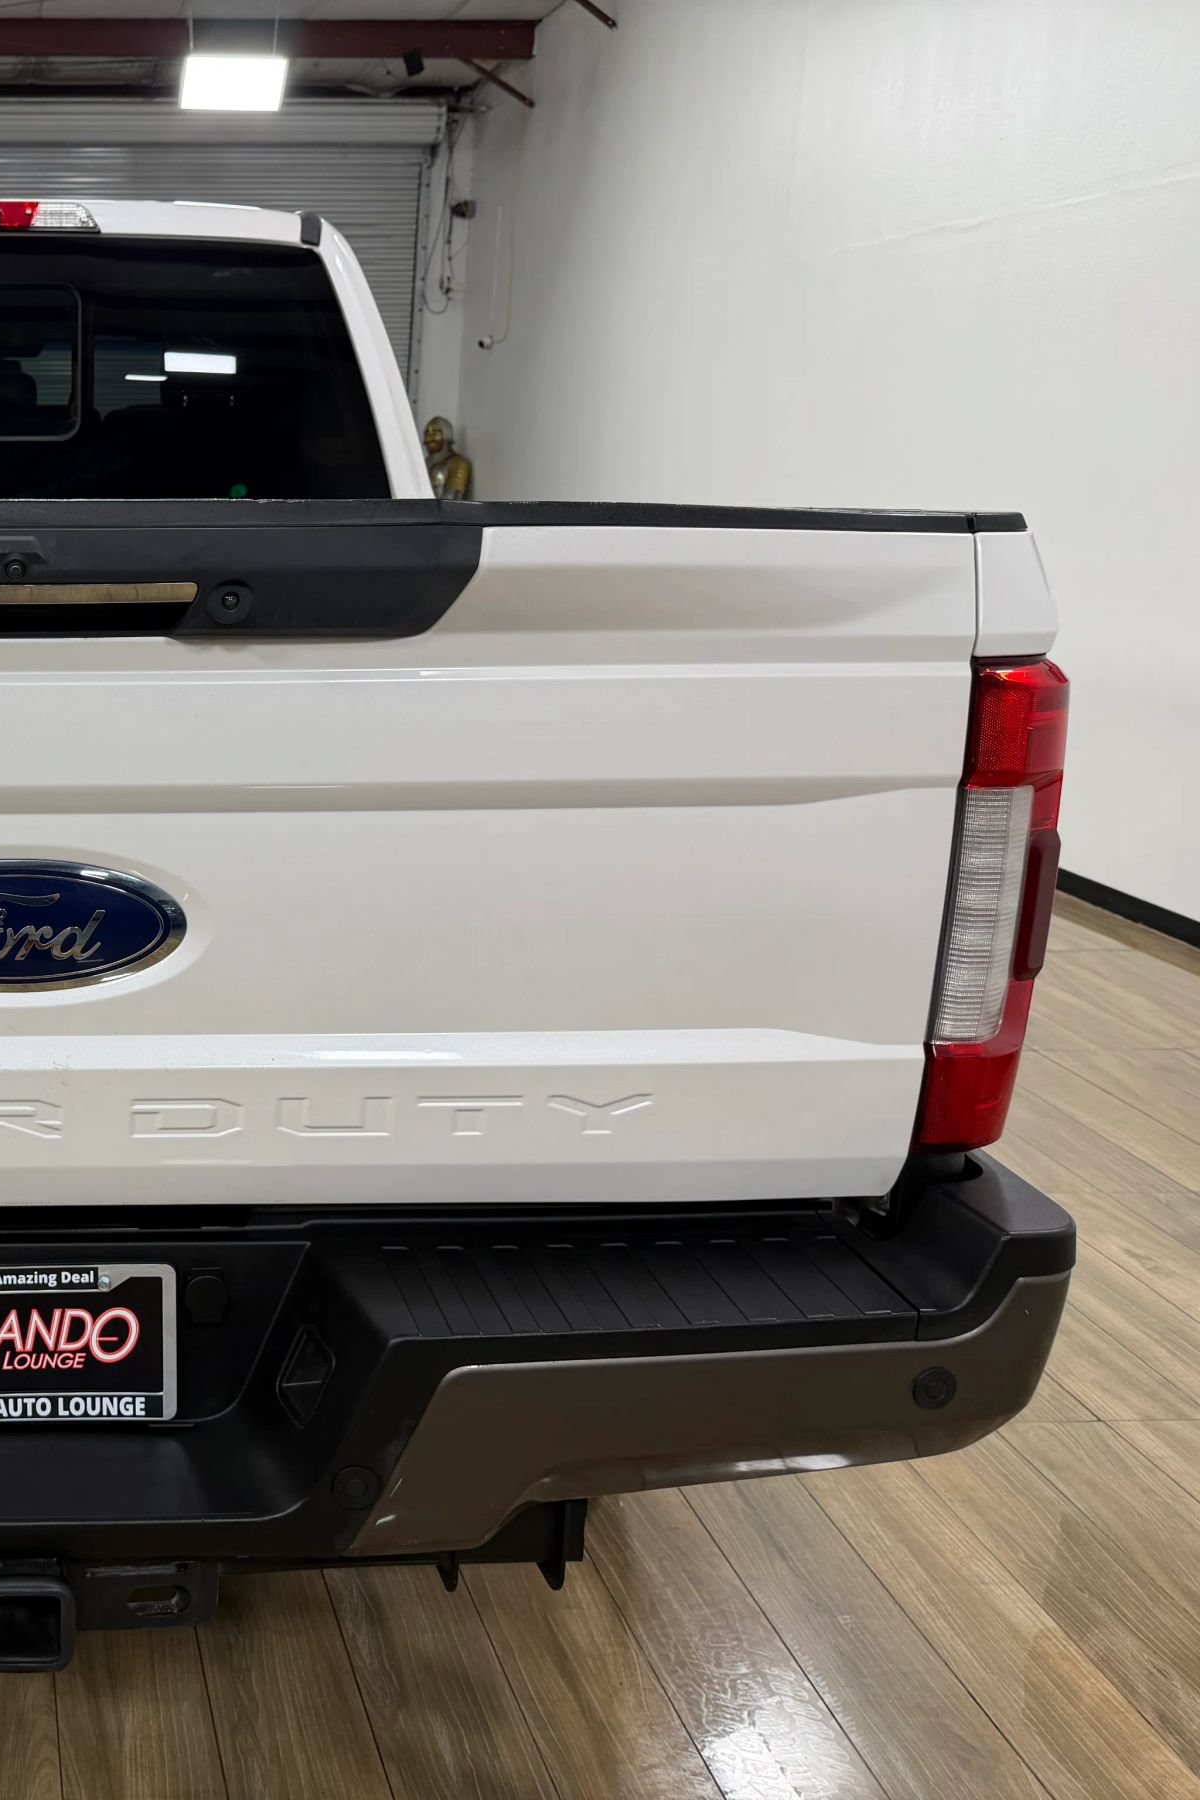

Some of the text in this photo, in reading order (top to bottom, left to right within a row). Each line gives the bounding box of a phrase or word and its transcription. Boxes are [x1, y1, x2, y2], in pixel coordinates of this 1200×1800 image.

[130, 1093, 655, 1138] DUTY
[61, 1270, 95, 1285] Deal
[57, 1396, 146, 1417] LOUNGE
